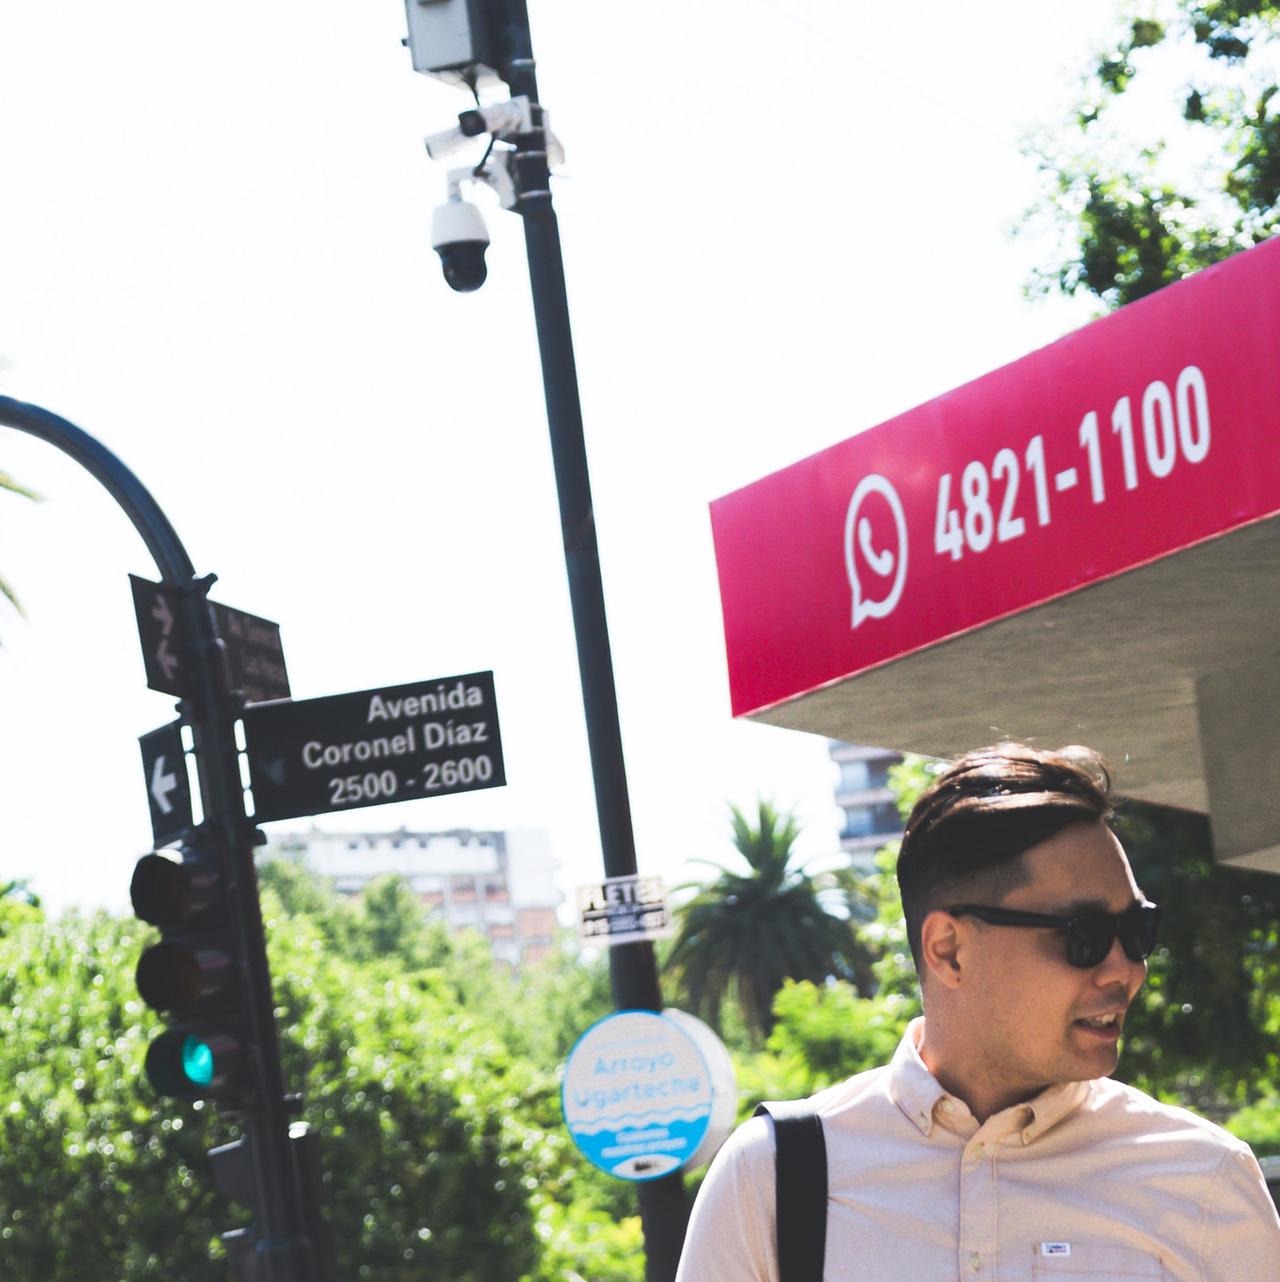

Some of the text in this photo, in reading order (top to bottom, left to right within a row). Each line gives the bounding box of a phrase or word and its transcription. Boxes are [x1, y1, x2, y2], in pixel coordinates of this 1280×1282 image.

[934, 365, 1211, 562] 4821-1100
[367, 681, 484, 724] Avenida
[302, 720, 489, 769] Coronel Díaz
[328, 769, 398, 805] 2500
[423, 754, 493, 790] 2600
[593, 1051, 675, 1078] Arroyo
[573, 1075, 701, 1109] Ugarteche
